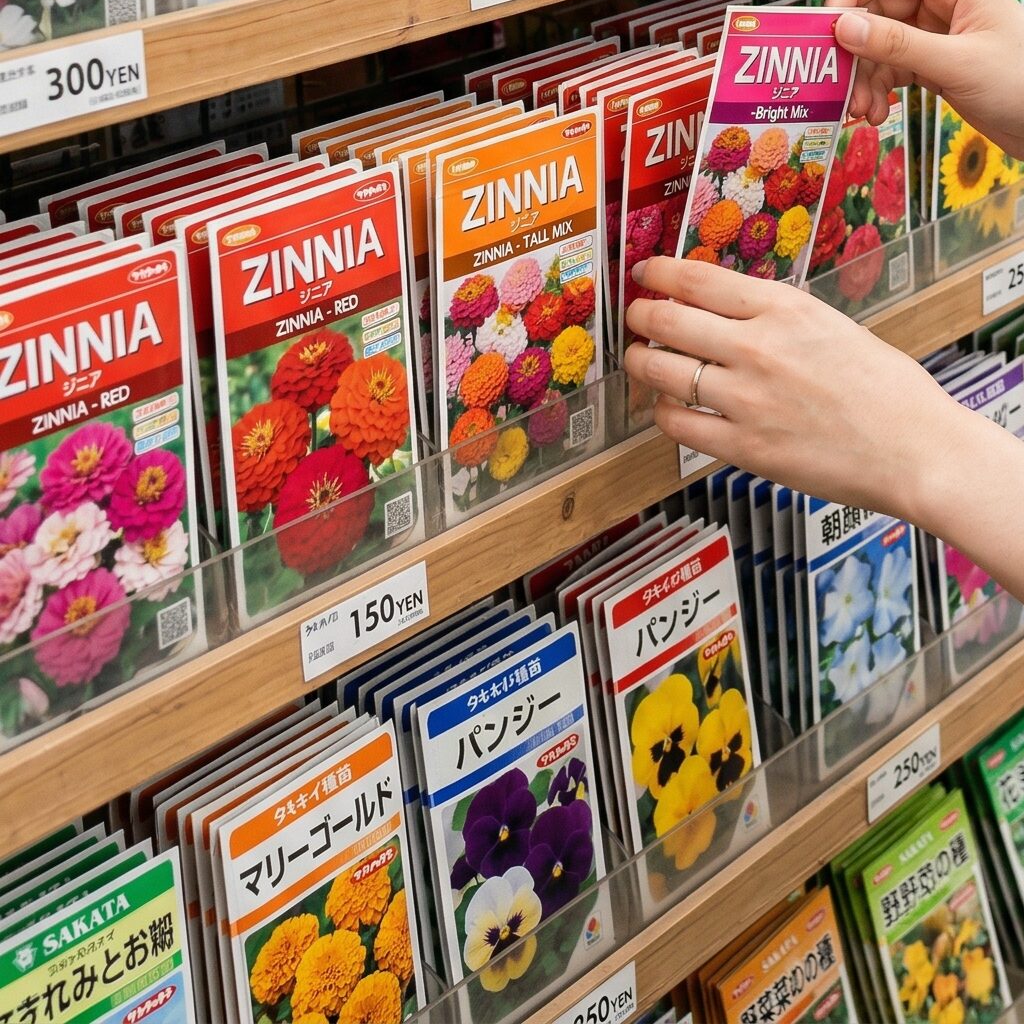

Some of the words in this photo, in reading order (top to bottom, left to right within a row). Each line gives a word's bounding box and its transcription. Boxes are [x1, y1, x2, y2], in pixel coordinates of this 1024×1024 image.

[734, 45, 839, 84] ZINNIA
[461, 155, 584, 232] ZINNIA
[241, 218, 385, 306] ZINNIA
[473, 244, 514, 268] ZINNIA
[523, 229, 549, 249] TALL
[552, 220, 573, 238] MIX
[276, 307, 324, 338] ZINNIA
[334, 294, 359, 316] RED
[299, 280, 333, 304] ジニア
[0, 301, 163, 400] ZINNIA
[31, 400, 89, 435] ZINNIA
[100, 385, 130, 410] RED
[63, 370, 102, 397] ジニア
[636, 589, 720, 658] パンジー
[456, 692, 561, 770] パンジー
[240, 776, 393, 896] マリーゴールド
[42, 893, 131, 957] SAKATA
